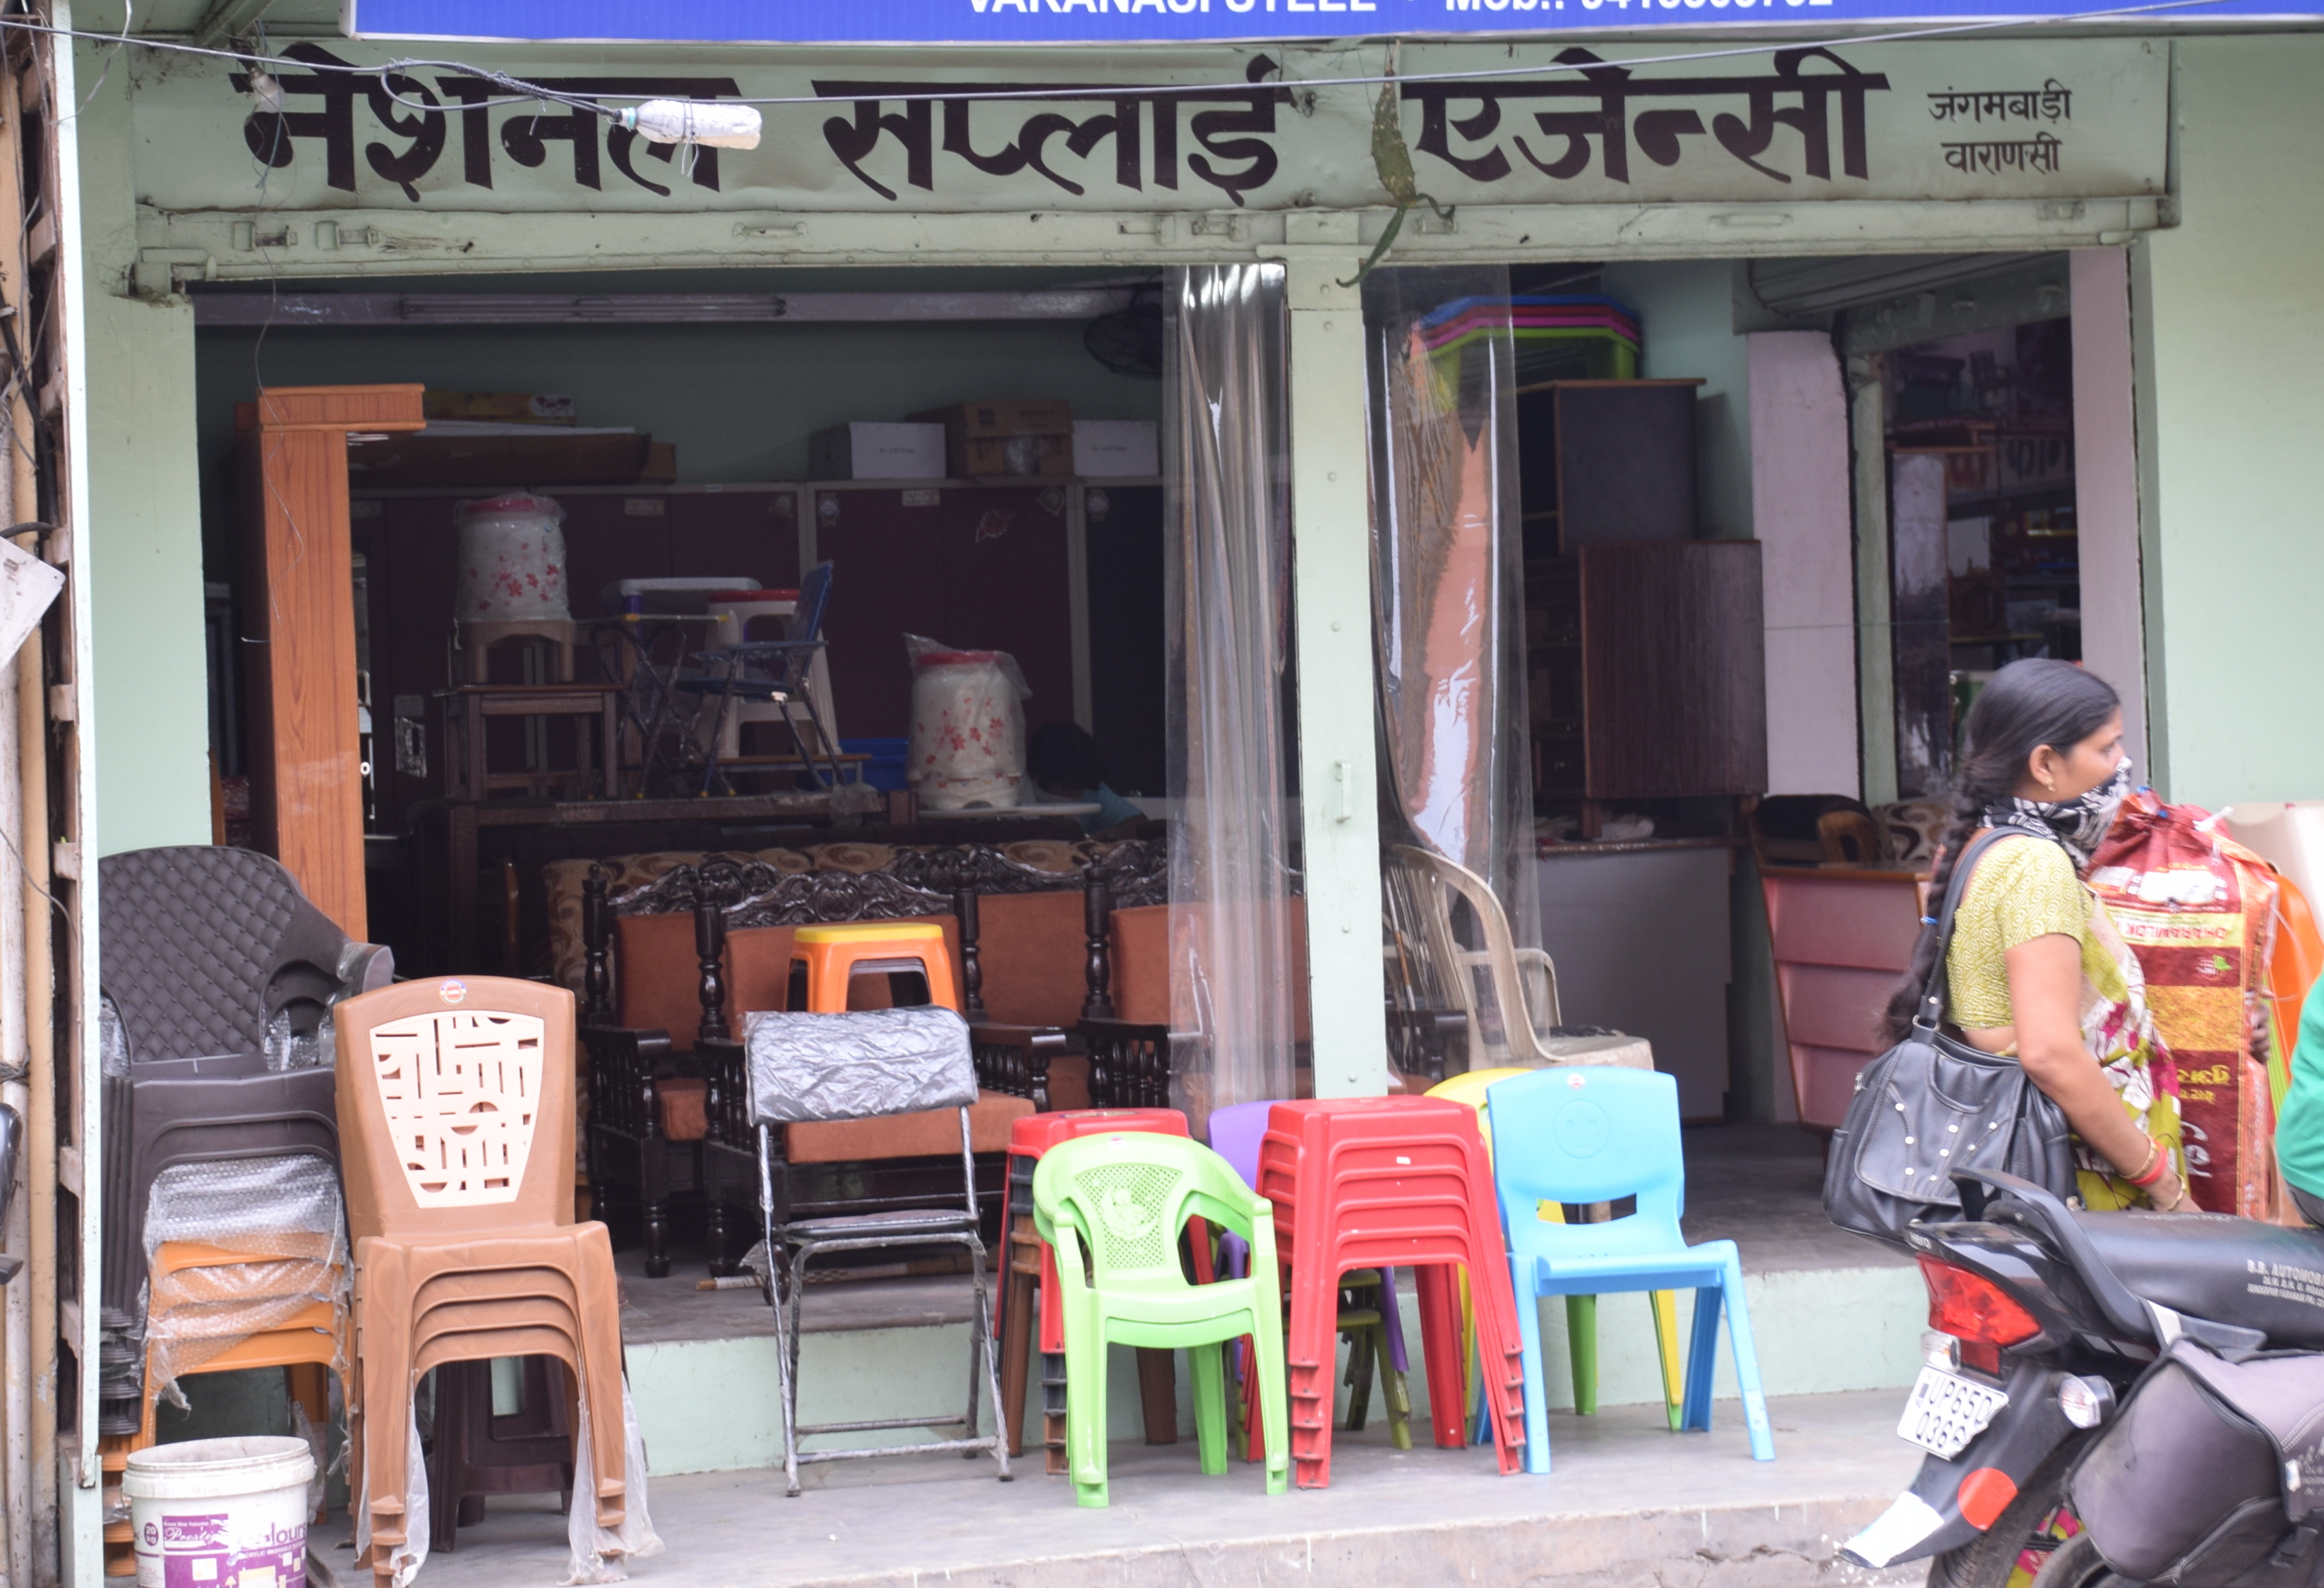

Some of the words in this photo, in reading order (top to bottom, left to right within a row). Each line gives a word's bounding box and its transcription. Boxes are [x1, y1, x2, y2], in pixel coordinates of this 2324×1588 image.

[1927, 78, 2072, 124] जंगमबाड़ी
[810, 53, 1296, 207] सप्लाई
[1401, 47, 1891, 185] एजेन्सी
[1941, 131, 2063, 176] वाराणसी
[145, 1525, 157, 1535] 20
